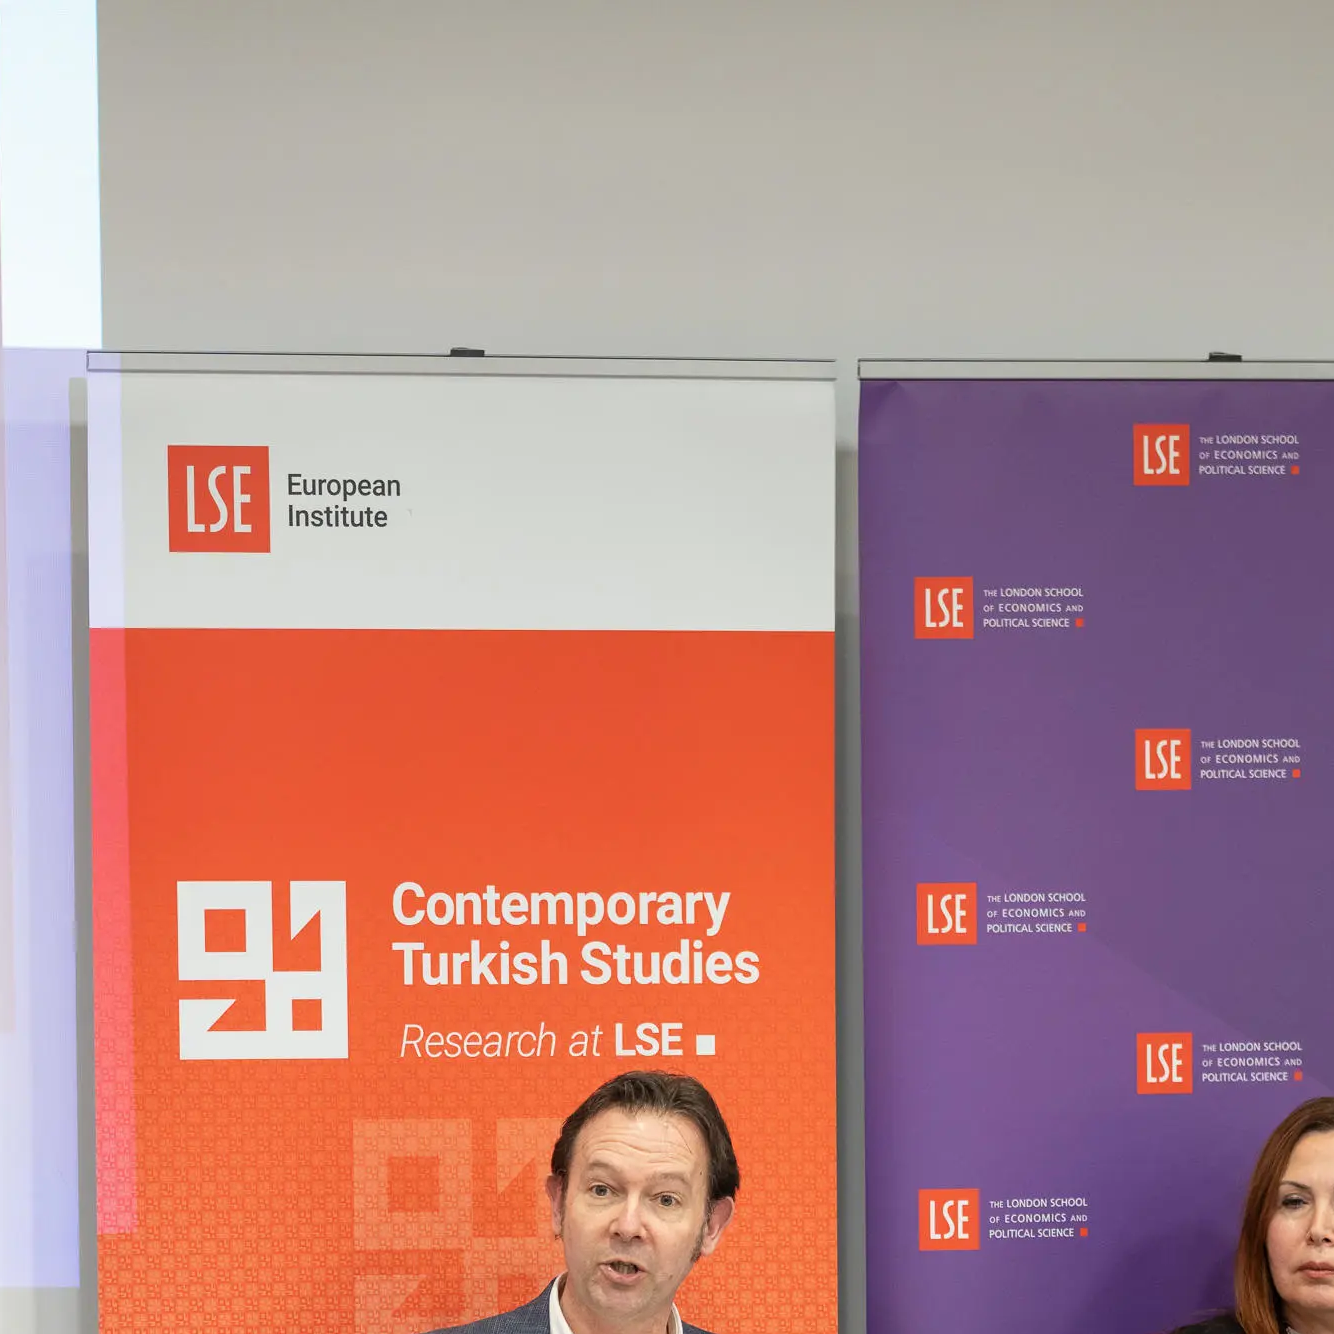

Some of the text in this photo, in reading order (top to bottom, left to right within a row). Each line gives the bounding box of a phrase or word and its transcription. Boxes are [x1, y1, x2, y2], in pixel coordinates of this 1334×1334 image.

[1199, 434, 1300, 445] THE LONDON SCHOOL
[1143, 434, 1181, 475] LSE
[1198, 449, 1300, 462] OF ECONOMICS AND
[1198, 464, 1287, 475] POLITICAL SCIENCE
[287, 473, 401, 502] European
[186, 465, 252, 533] LSE
[288, 504, 388, 528] Institute
[983, 587, 1085, 598] THE LONDON SCHOOL
[924, 587, 964, 628] LSE
[982, 602, 1084, 613] OF ECONOMICS AND
[982, 617, 1070, 628] POLITICAL SCIENCE
[1200, 737, 1301, 749] THE LONDON SCHOOL
[1144, 739, 1182, 780] LSE
[1199, 753, 1301, 765] OF ECONOMICS AND
[1199, 768, 1287, 779] POLITICAL SCIENCE
[986, 892, 1087, 904] THE LONDON SCHOOL
[392, 881, 731, 937] Contemporary
[927, 893, 967, 934] LSE
[986, 907, 1087, 919] OF ECONOMICS AND
[986, 922, 1073, 934] POLITICAL SCIENCE
[391, 939, 760, 986] Turkish Studies
[400, 1021, 684, 1058] Research at LSE
[1202, 1040, 1304, 1052] THE LONDON SCHOOL
[1146, 1043, 1183, 1083] LSE
[1201, 1056, 1303, 1068] OF ECONOMICS AND
[1201, 1071, 1289, 1083] POLITICAL SCIENCE
[989, 1196, 1088, 1209] THE LONDON SCHOOL
[929, 1199, 970, 1240] LSE
[988, 1211, 1088, 1225] OF ECONOMICS AND
[988, 1227, 1075, 1240] POLITICAL SCIENCE
